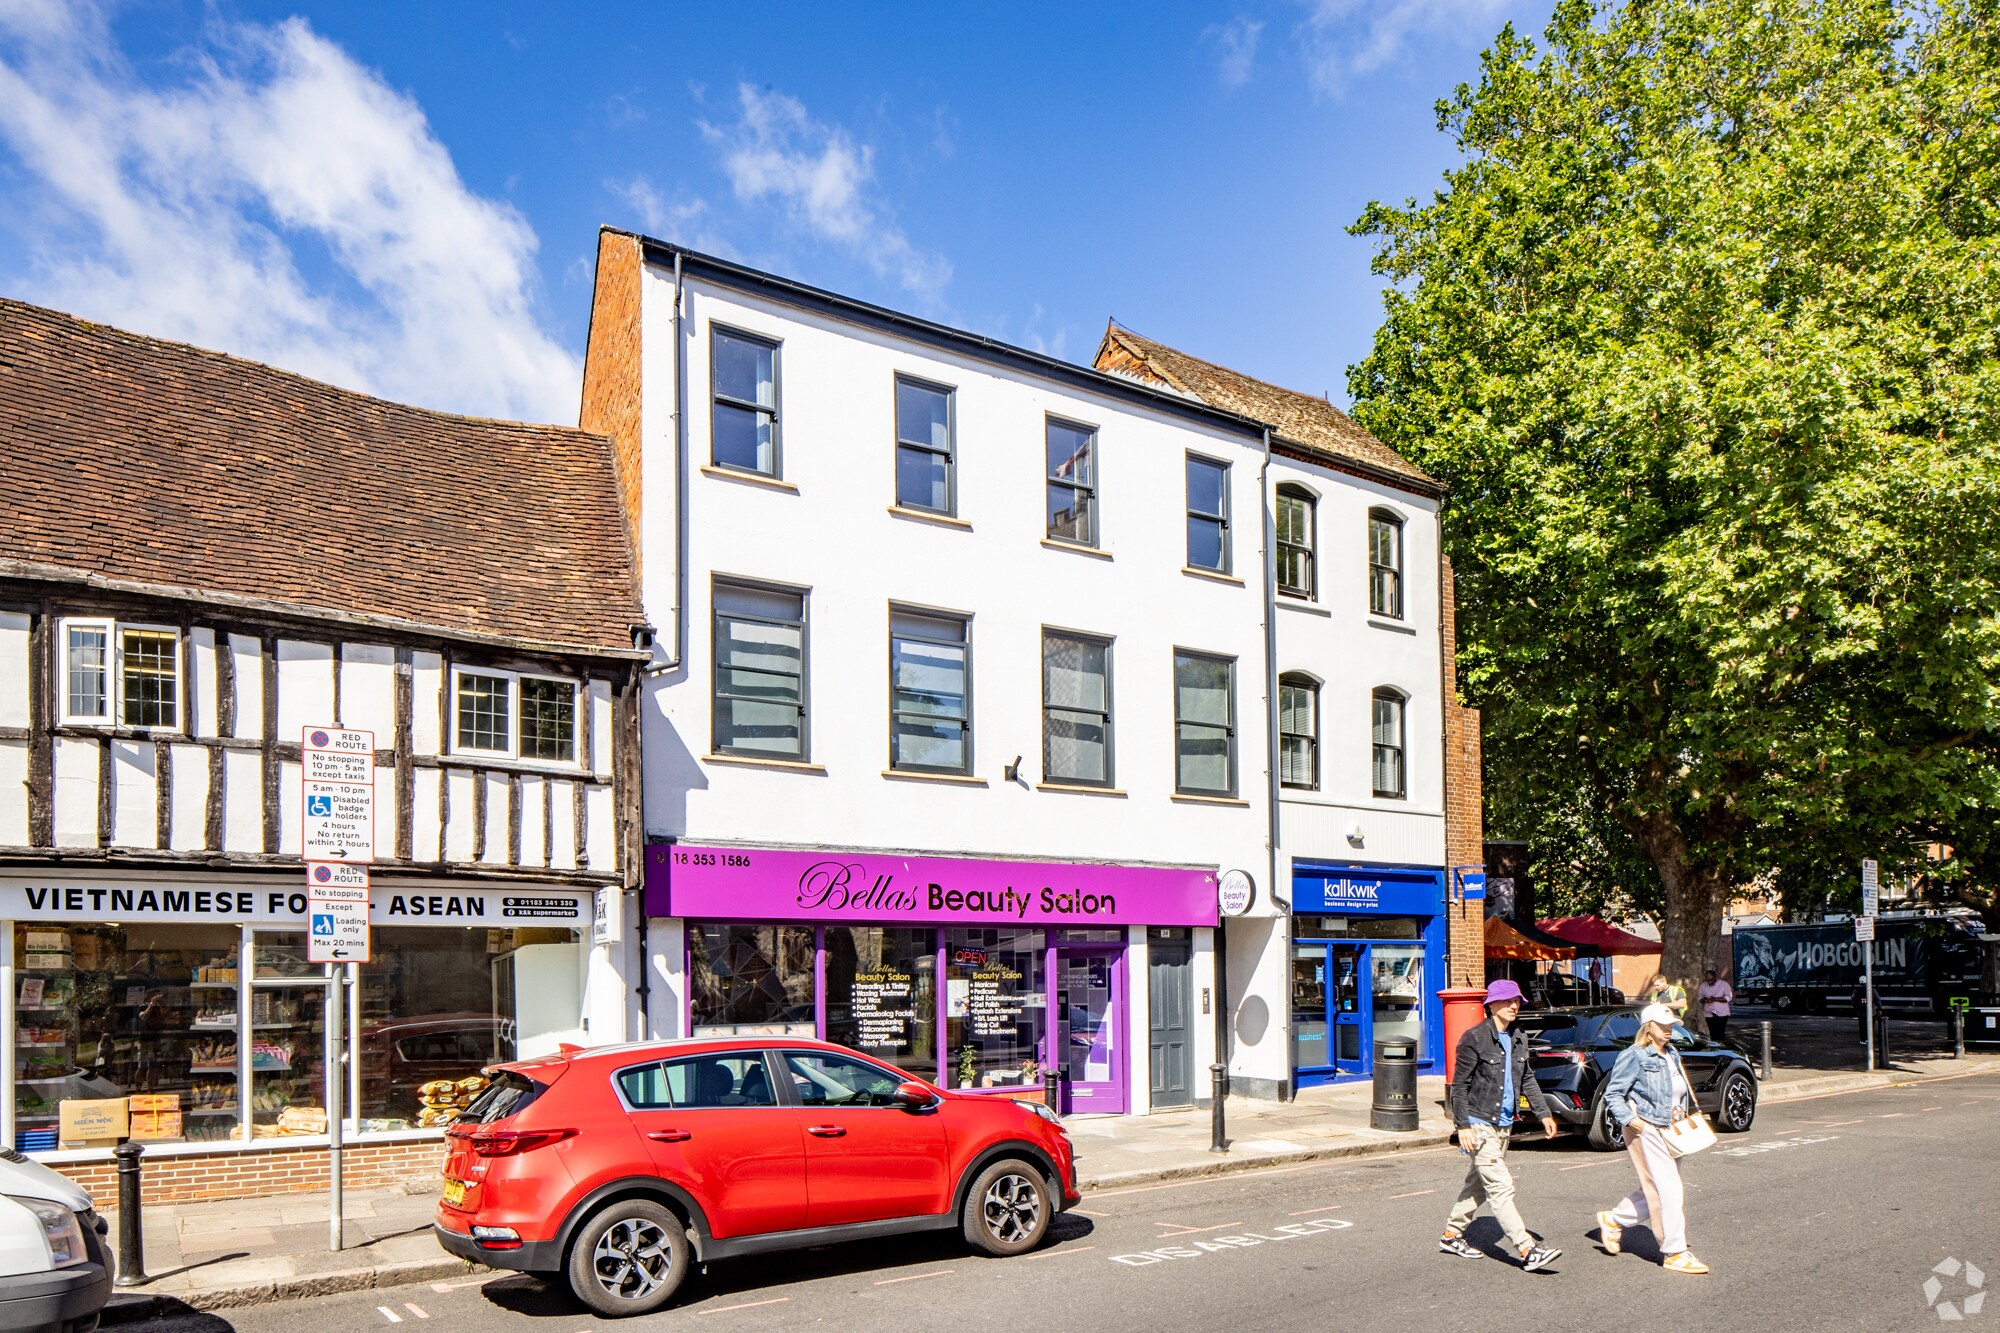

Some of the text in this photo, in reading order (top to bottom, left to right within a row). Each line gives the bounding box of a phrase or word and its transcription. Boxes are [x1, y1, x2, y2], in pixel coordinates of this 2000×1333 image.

[336, 742, 367, 750] ROUTE
[328, 754, 364, 764] stopping
[344, 772, 364, 780] taxis
[333, 796, 369, 804] Disabled
[339, 805, 364, 813] badge
[693, 854, 715, 866] 353
[721, 855, 750, 867] 1586
[329, 890, 363, 898] stopping
[796, 861, 1115, 918] Bellas Beauty Salon
[1224, 892, 1246, 900] Beauty
[25, 887, 253, 913] VIETNAMESE
[389, 895, 485, 916] ASEAN
[325, 903, 352, 911] Except
[956, 951, 987, 964] OPEN
[855, 973, 886, 982] Beauty
[973, 971, 1022, 980] Beauty Salon
[1108, 1218, 1353, 1266] DISABLED
